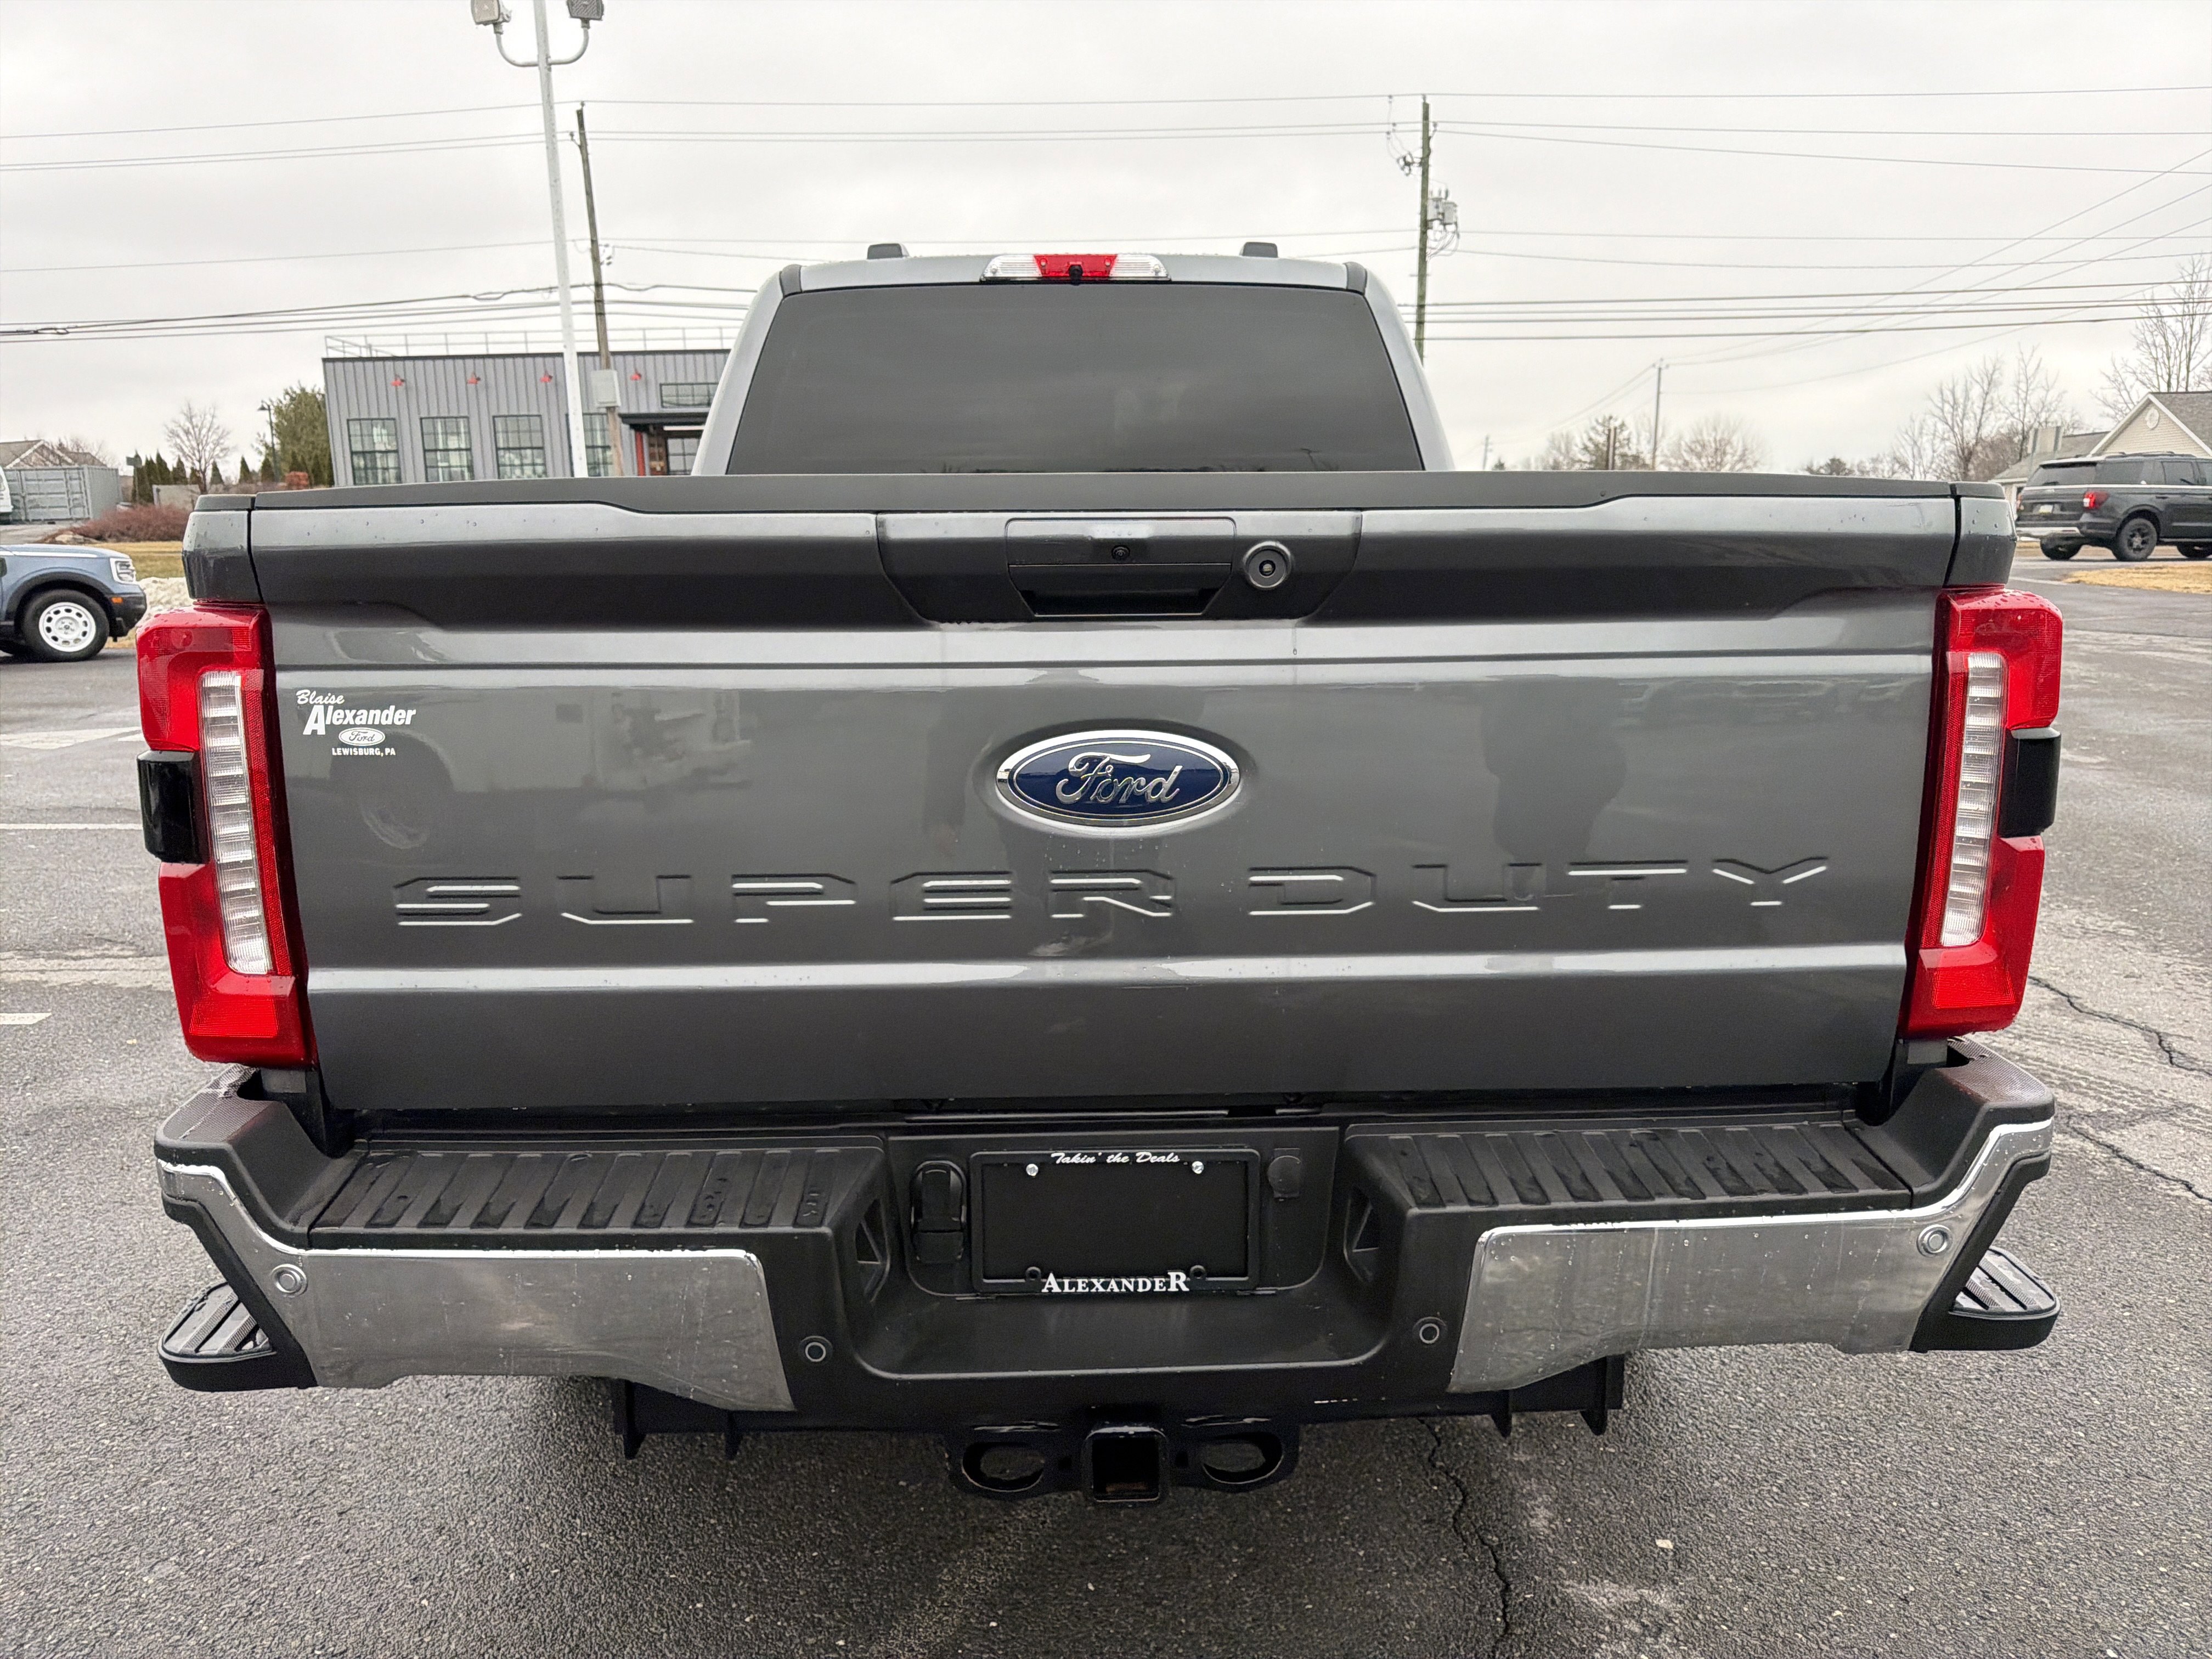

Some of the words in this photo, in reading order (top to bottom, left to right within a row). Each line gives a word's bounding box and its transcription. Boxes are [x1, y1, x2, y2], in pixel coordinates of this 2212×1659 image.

[296, 689, 345, 704] Blaise
[302, 705, 416, 735] Alexander
[348, 730, 375, 742] Ford
[332, 748, 383, 757] LEWISBURG,
[1056, 752, 1180, 804] Ford
[393, 869, 1173, 926] SUPER
[1248, 856, 1828, 916] DUTY
[1106, 1152, 1130, 1163] the
[1136, 1151, 1180, 1163] Deals
